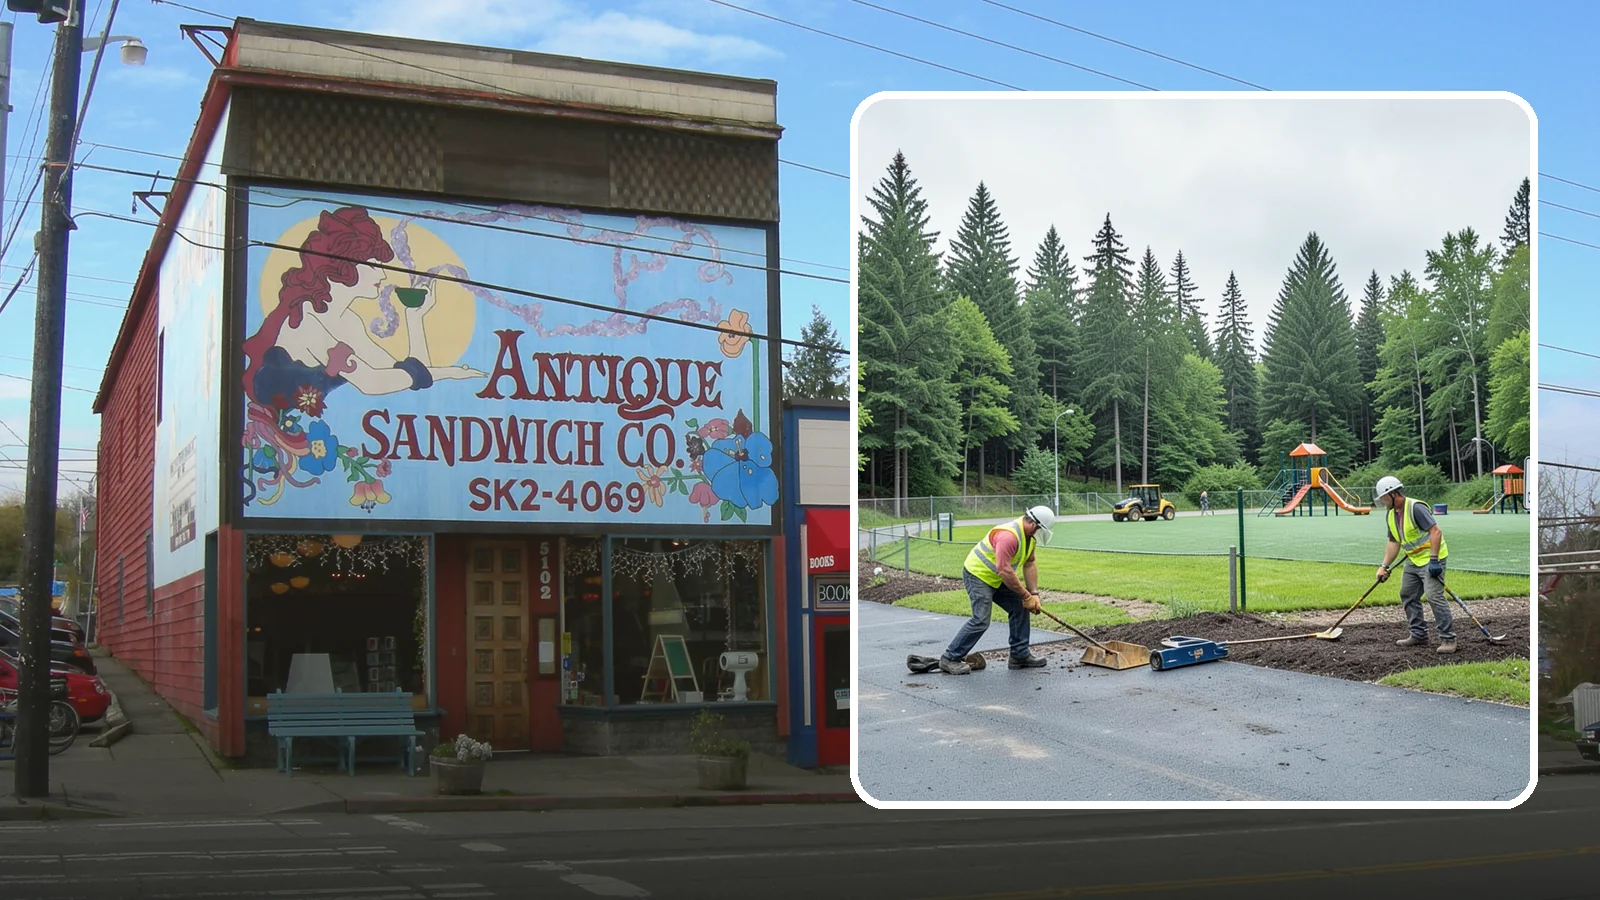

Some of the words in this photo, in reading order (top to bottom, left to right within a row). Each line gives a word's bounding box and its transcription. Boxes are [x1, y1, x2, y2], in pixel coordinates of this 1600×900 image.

[475, 329, 723, 421] ANTIQUE
[361, 408, 605, 467] SANDWICH
[616, 421, 685, 469] CO.
[468, 477, 646, 514] SK2-4069
[539, 541, 552, 600] 5102
[809, 555, 835, 569] BOOKS
